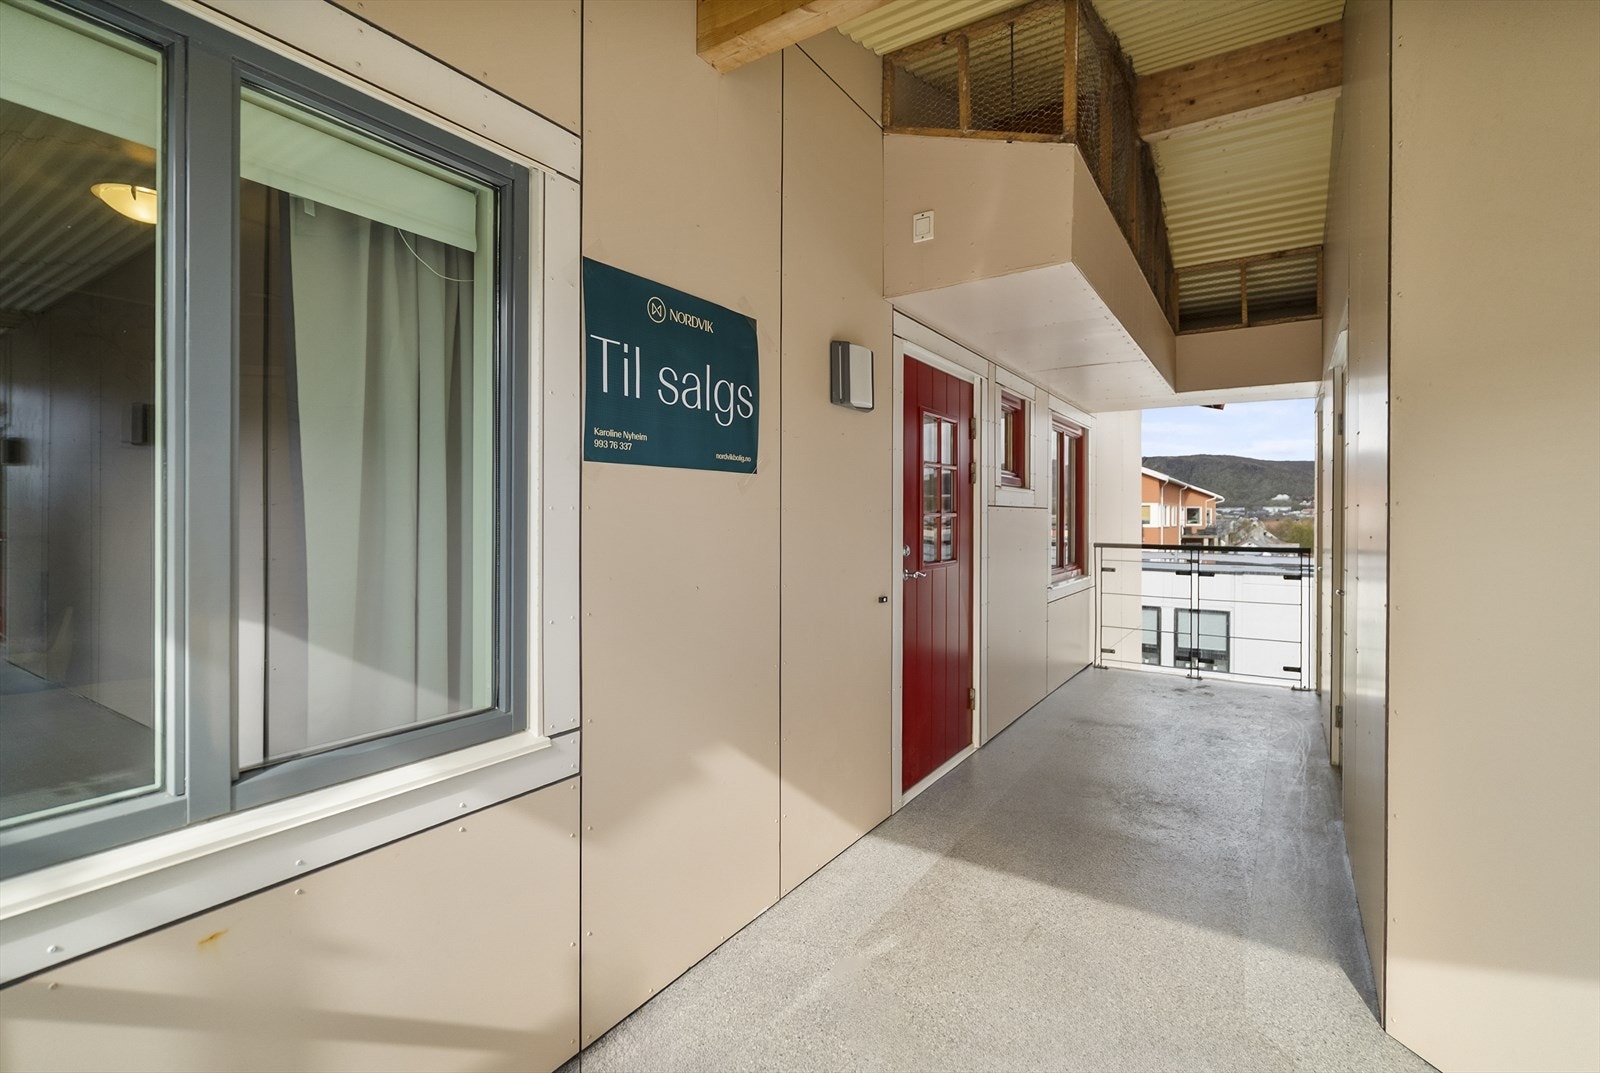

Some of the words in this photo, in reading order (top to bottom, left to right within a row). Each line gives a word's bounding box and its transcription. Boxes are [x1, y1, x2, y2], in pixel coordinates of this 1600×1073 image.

[669, 308, 714, 333] NORDVIK
[590, 334, 640, 399] Til
[657, 364, 754, 427] salgs
[594, 427, 622, 438] Karoline
[623, 430, 647, 441] Nyheim
[594, 439, 608, 448] 993
[609, 441, 618, 449] 76
[619, 442, 632, 450] 337
